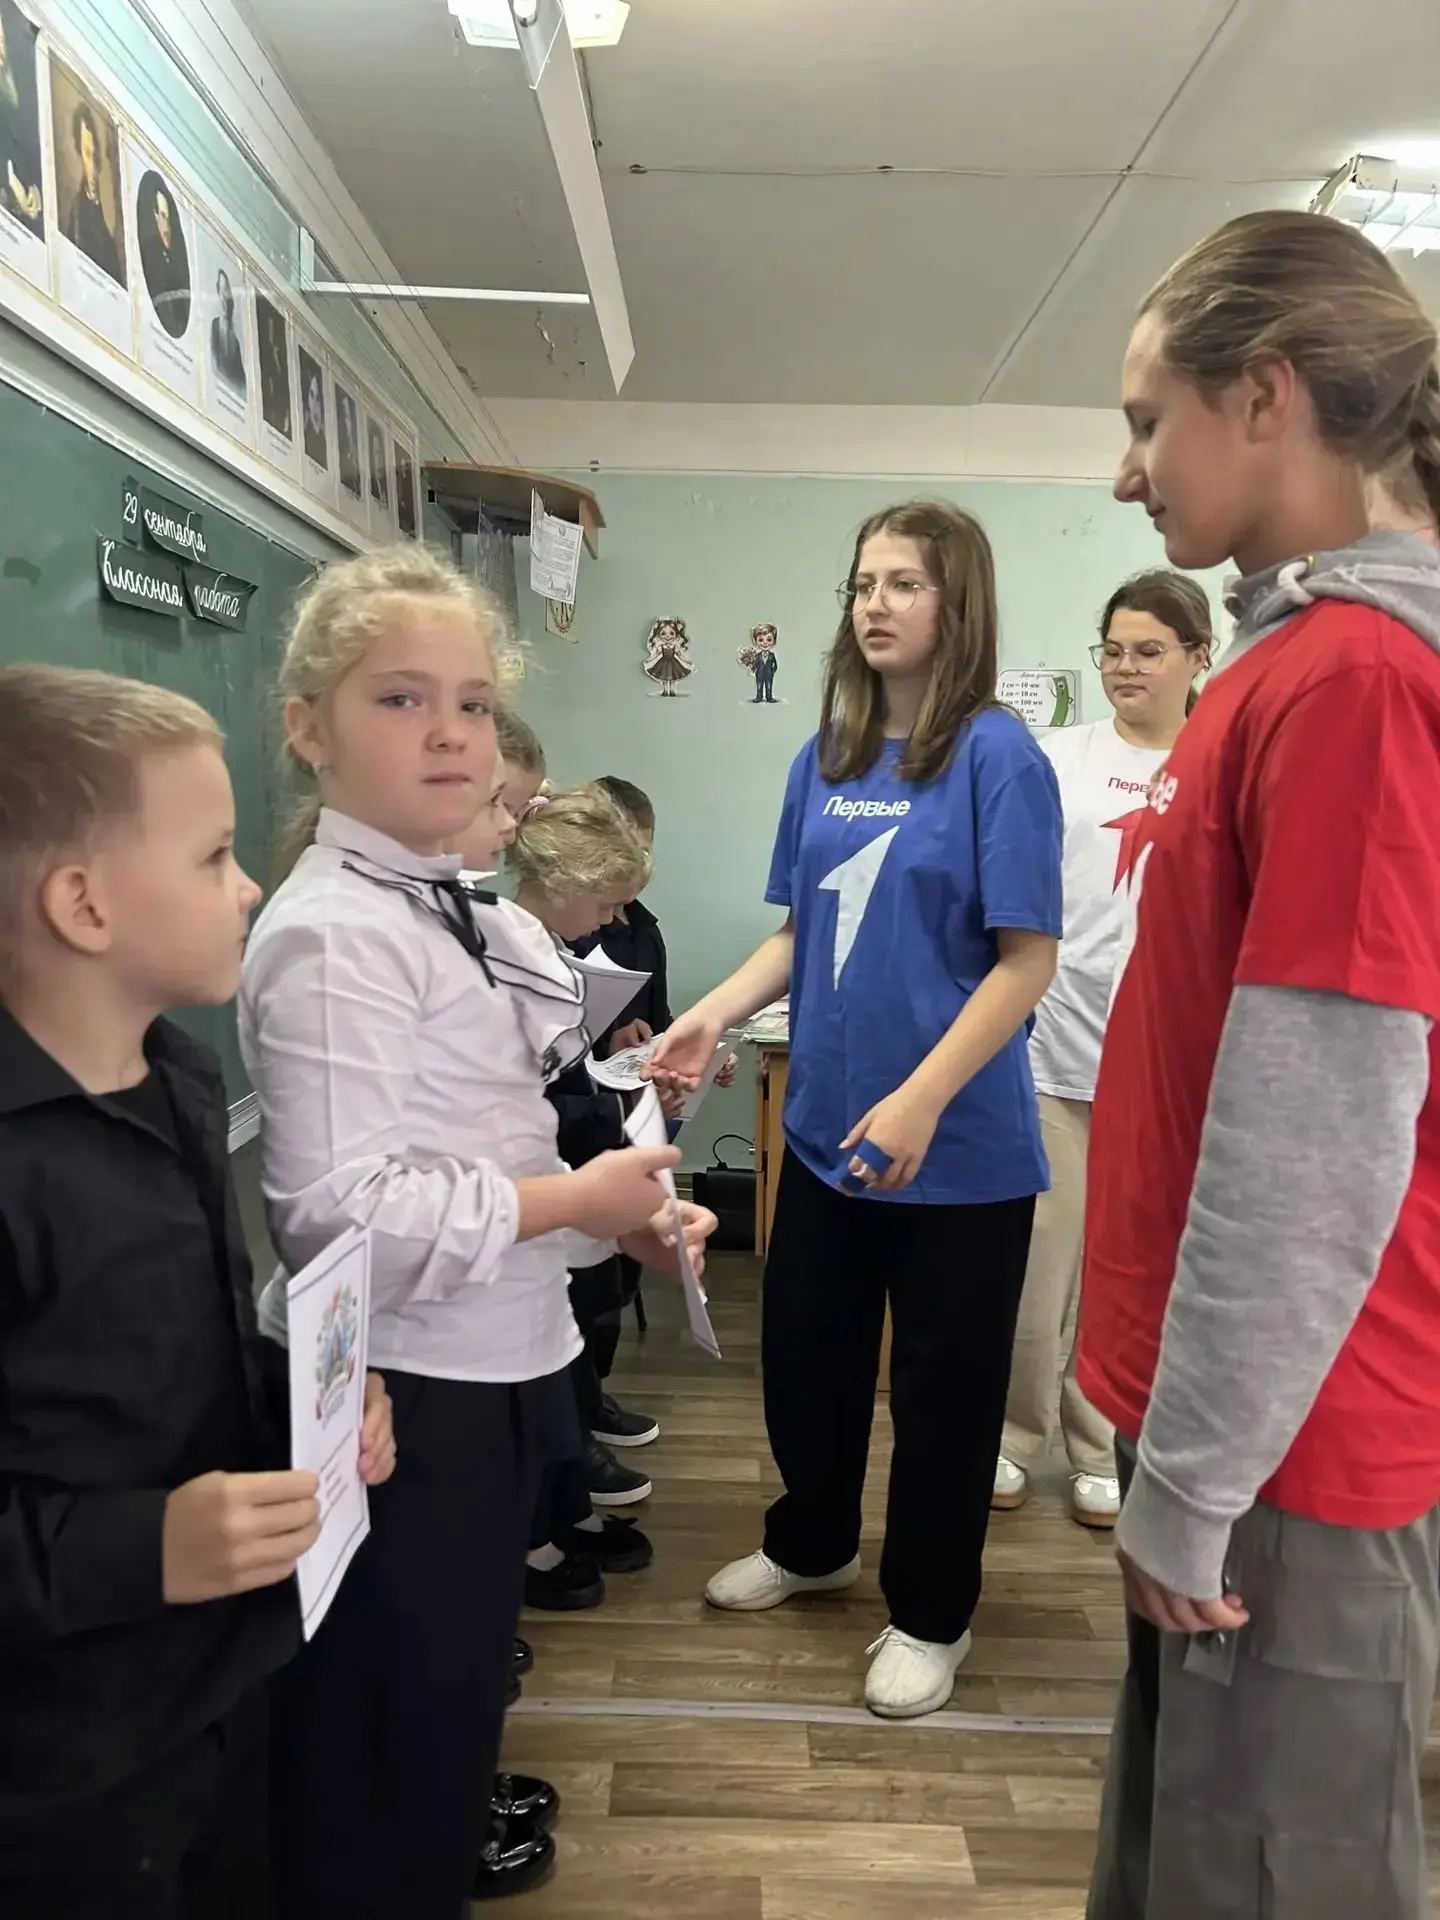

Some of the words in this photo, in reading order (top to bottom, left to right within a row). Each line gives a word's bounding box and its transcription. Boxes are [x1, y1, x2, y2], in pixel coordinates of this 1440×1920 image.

[123, 492, 138, 525] 29
[144, 509, 207, 562] сентября
[102, 539, 184, 608] Классная
[194, 573, 241, 618] работа
[822, 796, 911, 822] Первые
[1107, 776, 1150, 794] Перв
